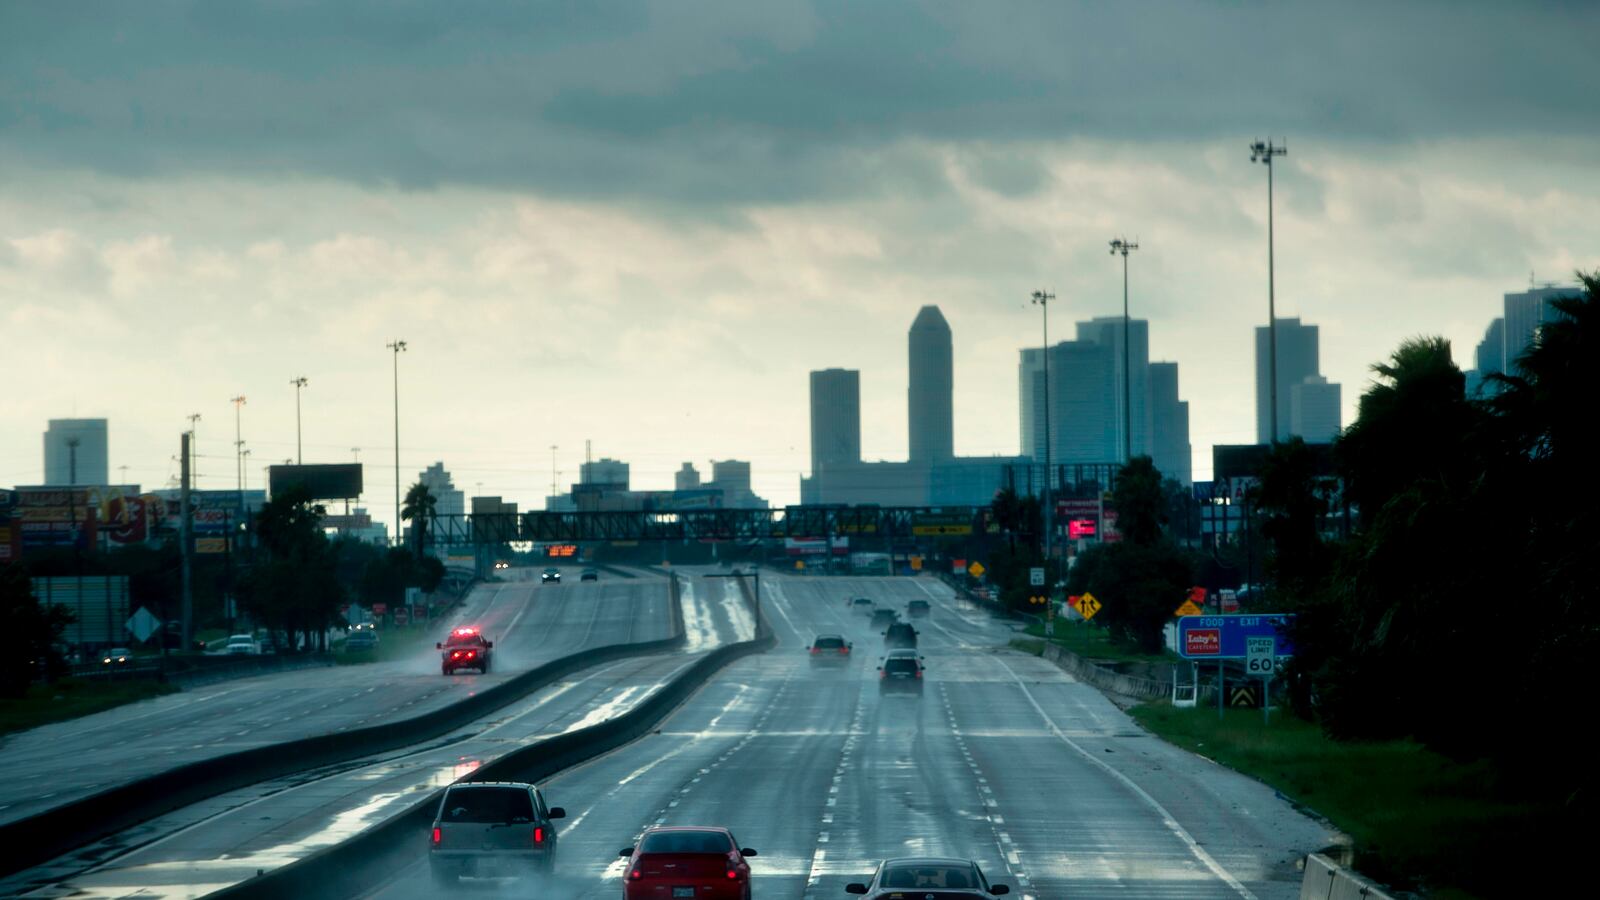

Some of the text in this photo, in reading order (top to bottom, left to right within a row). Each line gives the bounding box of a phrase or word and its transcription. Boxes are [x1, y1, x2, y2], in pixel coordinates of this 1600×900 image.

[1200, 618, 1224, 627] FOOD
[1240, 617, 1260, 626] EXIT
[1250, 646, 1270, 654] LIMIT
[1249, 658, 1272, 671] 60
